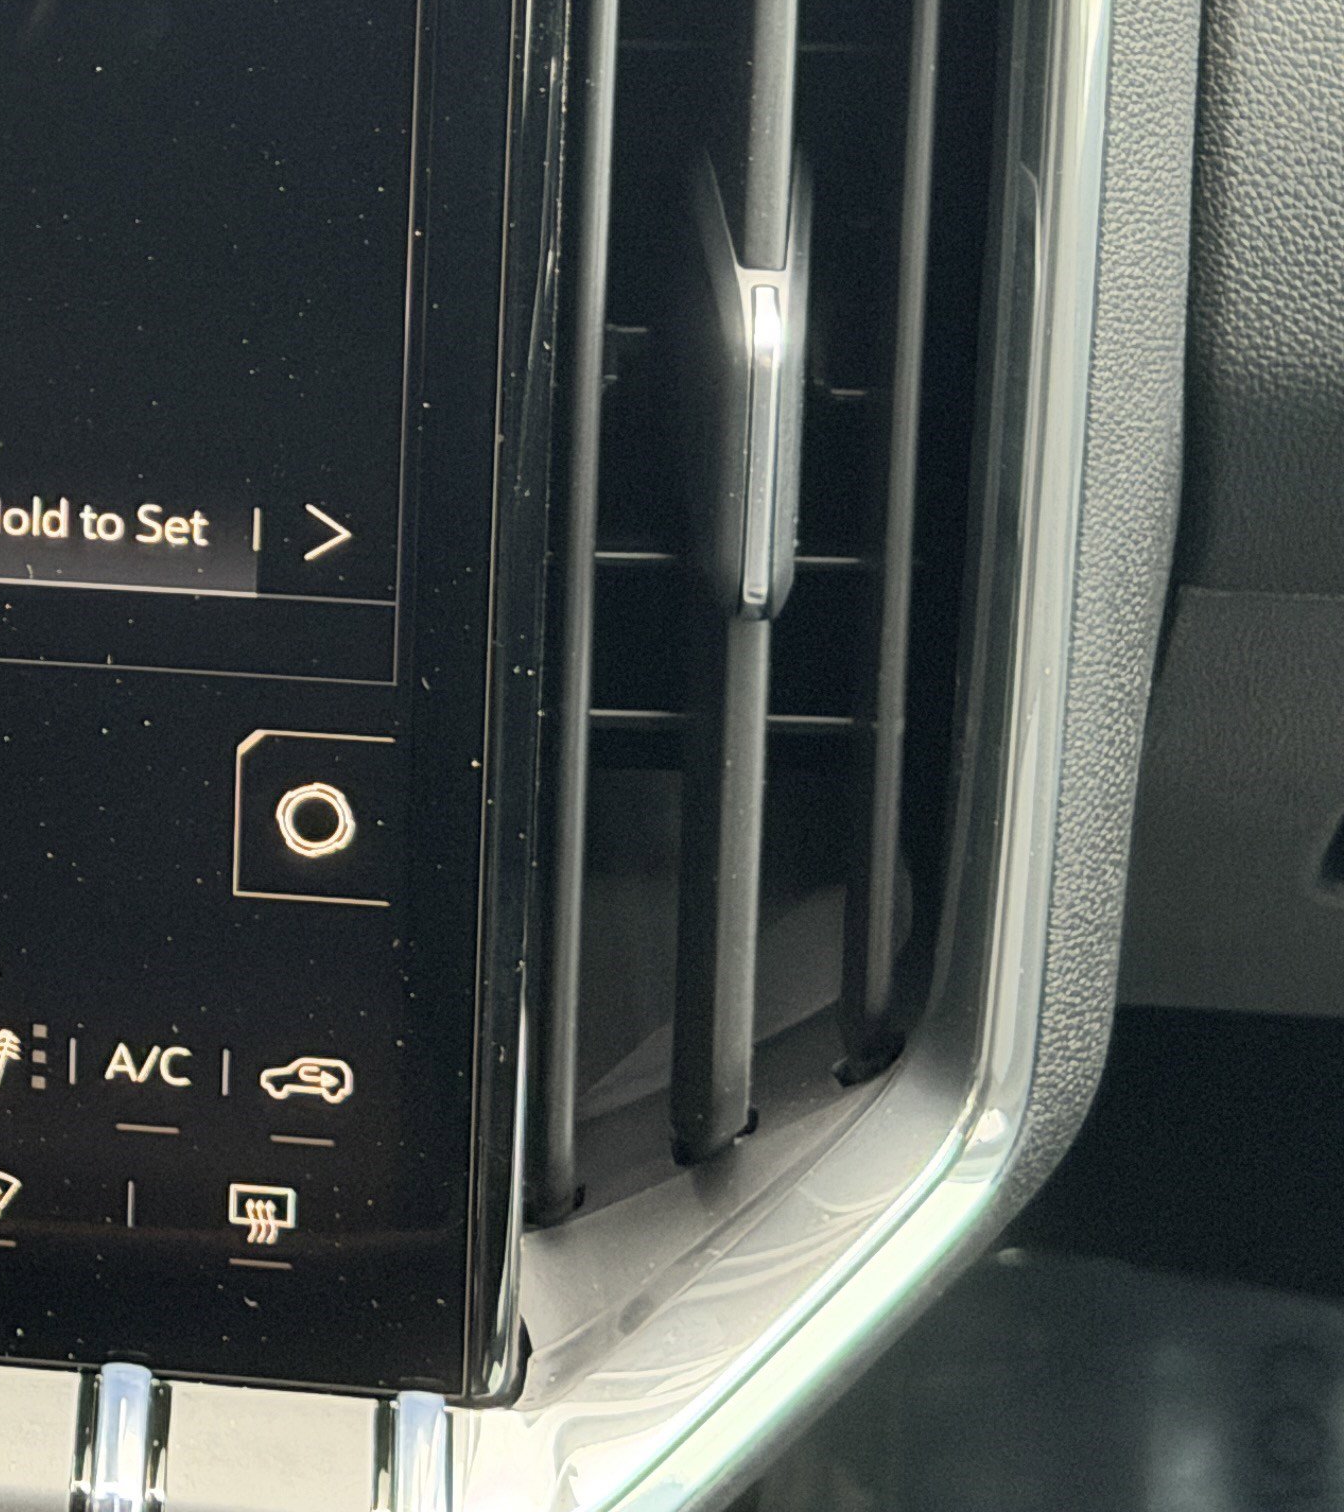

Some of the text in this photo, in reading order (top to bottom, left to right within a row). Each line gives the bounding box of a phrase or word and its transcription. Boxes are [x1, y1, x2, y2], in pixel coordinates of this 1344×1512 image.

[78, 503, 126, 543] to
[134, 502, 211, 549] Set
[103, 1041, 193, 1088] A/C
